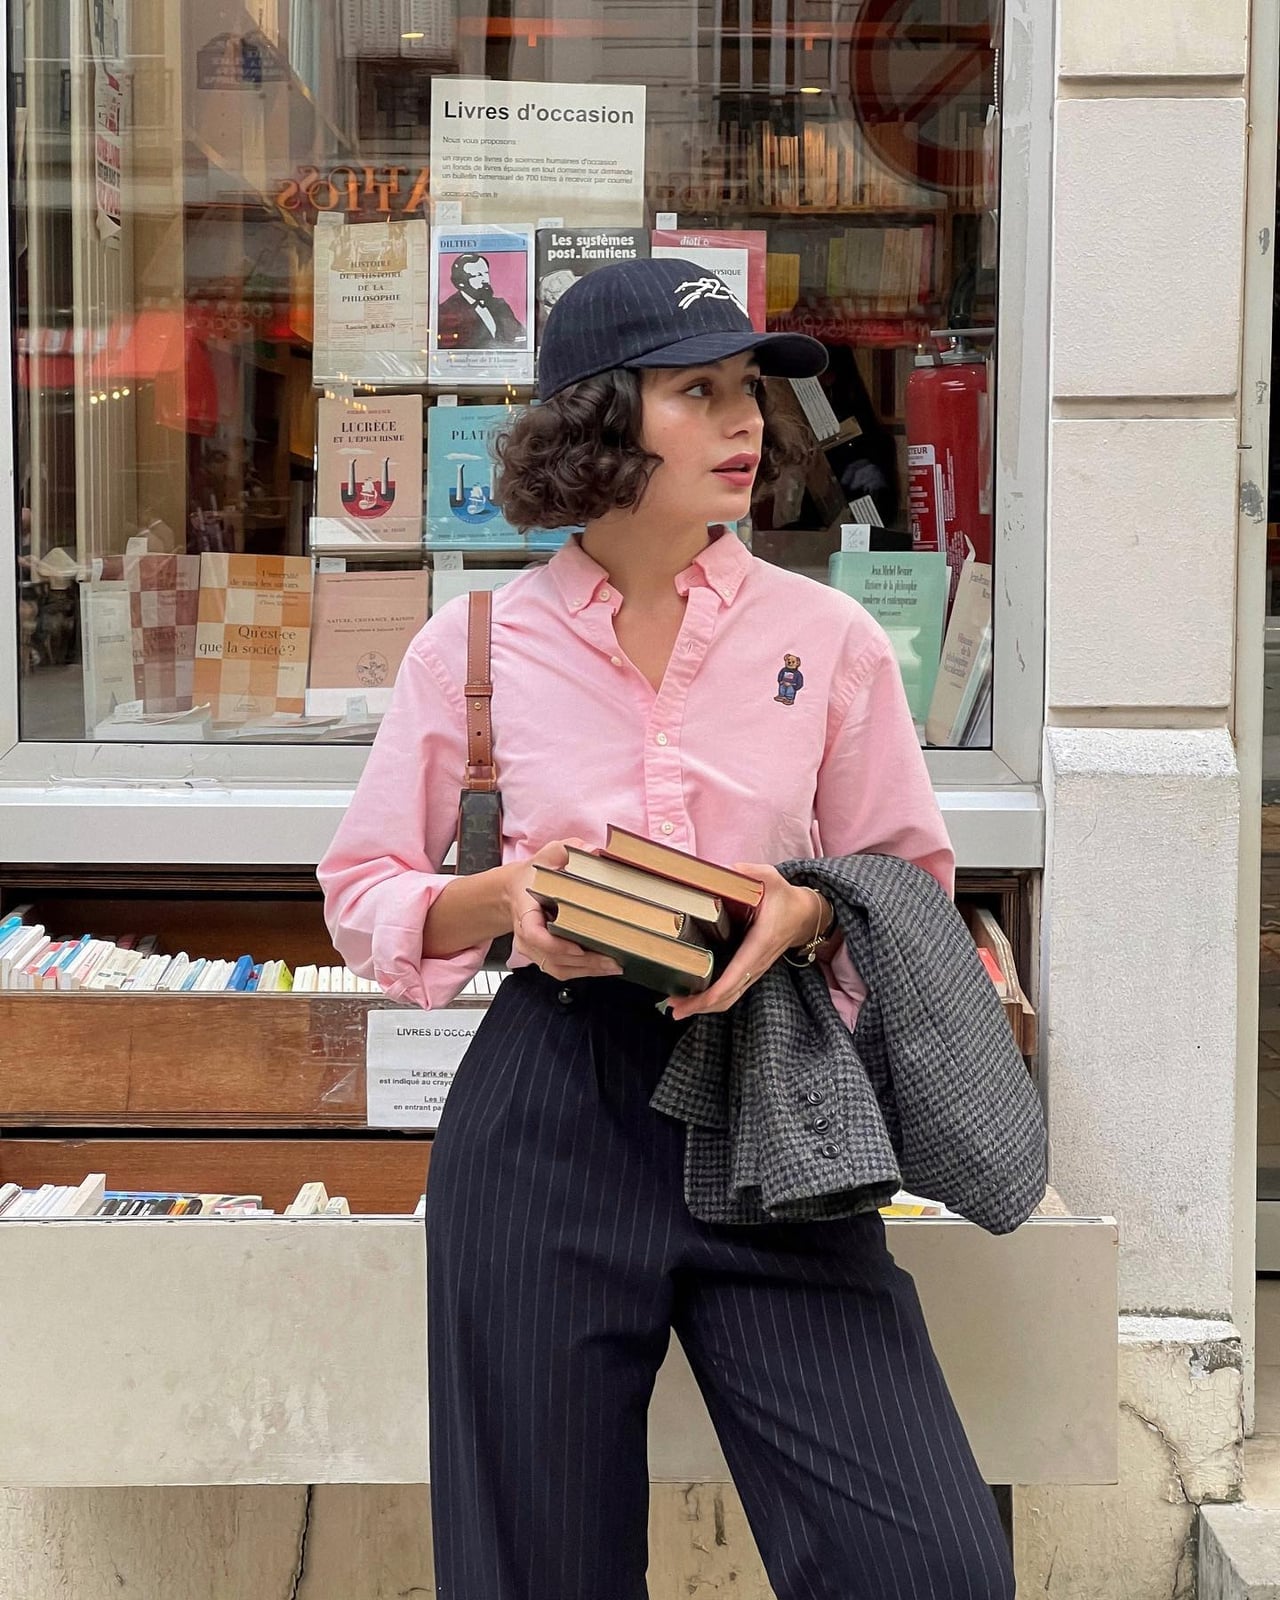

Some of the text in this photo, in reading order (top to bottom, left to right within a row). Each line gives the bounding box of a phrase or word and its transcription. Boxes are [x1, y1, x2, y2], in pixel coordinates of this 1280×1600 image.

[444, 101, 634, 124] Livres d'occasion
[440, 240, 477, 248] DILTHEY
[551, 233, 634, 248] Les systèmes
[713, 268, 741, 276] HYSIQUE
[342, 294, 400, 302] PHILOSOPHIE
[341, 419, 397, 432] LUCRÈCE
[909, 446, 928, 455] TEUR
[238, 625, 297, 640] Qu'est-ce
[199, 643, 222, 655] que
[227, 641, 238, 653] la
[397, 1028, 432, 1036] LIVRES
[422, 1071, 437, 1079] prix
[392, 1079, 420, 1087] indiqué
[404, 1104, 431, 1112] entrant
